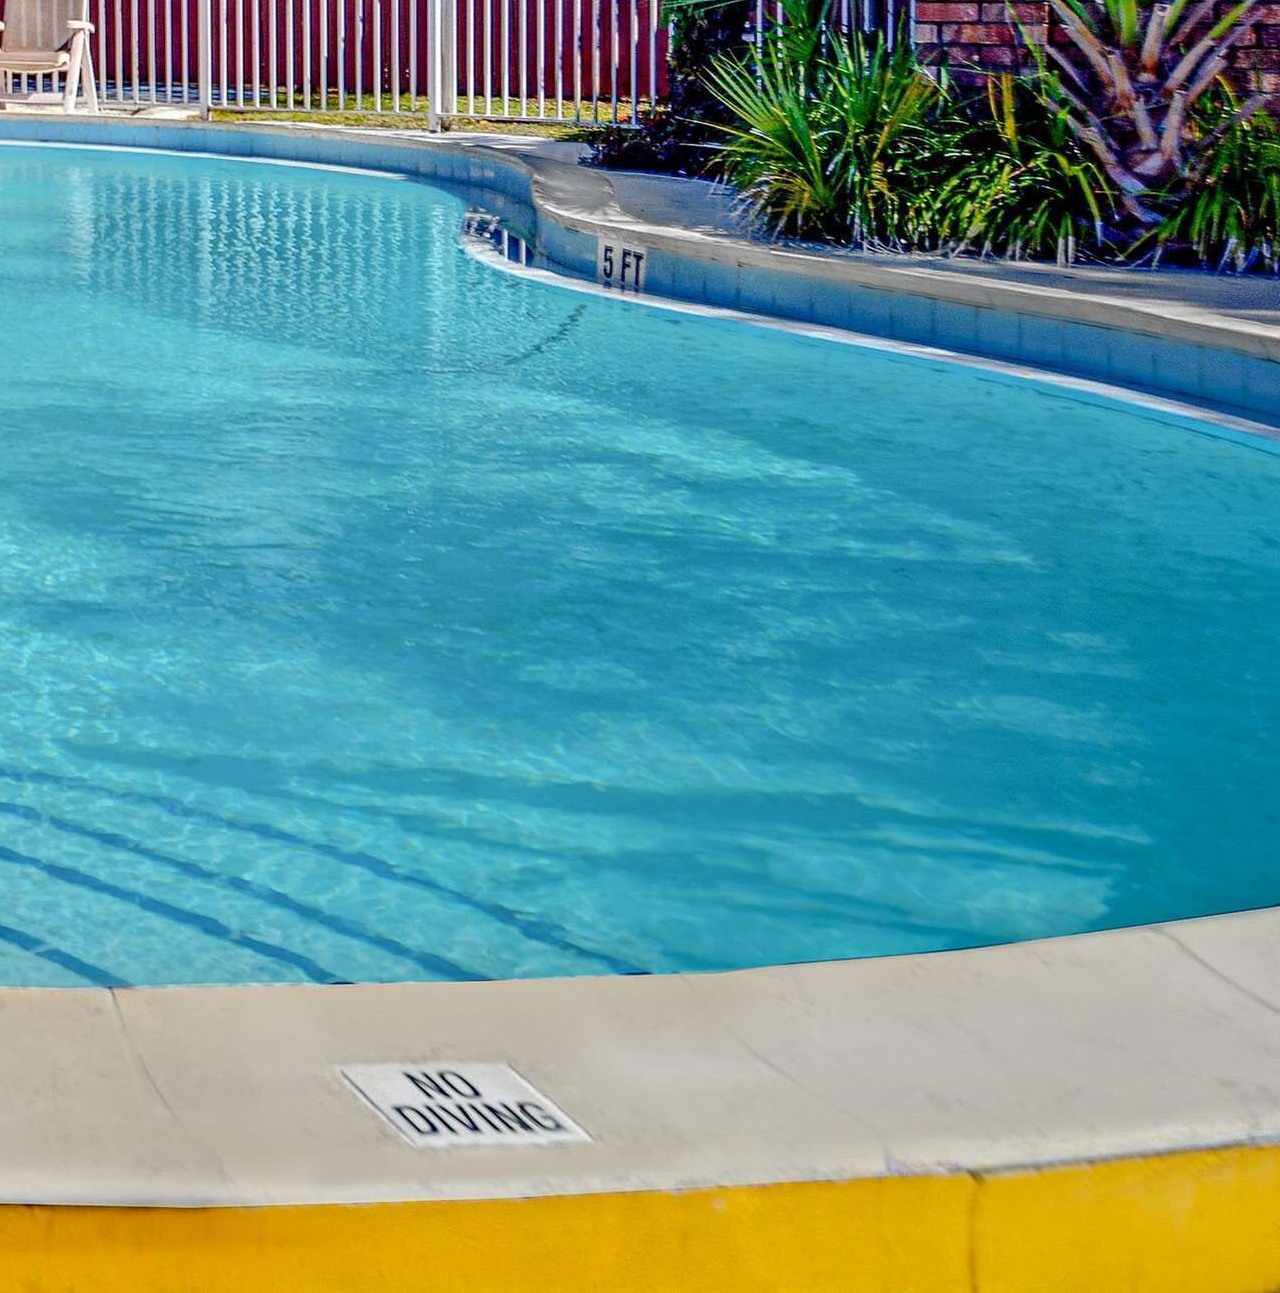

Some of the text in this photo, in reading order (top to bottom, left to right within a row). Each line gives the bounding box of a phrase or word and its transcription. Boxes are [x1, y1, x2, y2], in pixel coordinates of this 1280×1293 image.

[603, 246, 644, 286] 5 FT
[402, 1070, 482, 1099] NO
[391, 1102, 567, 1136] DIVING
